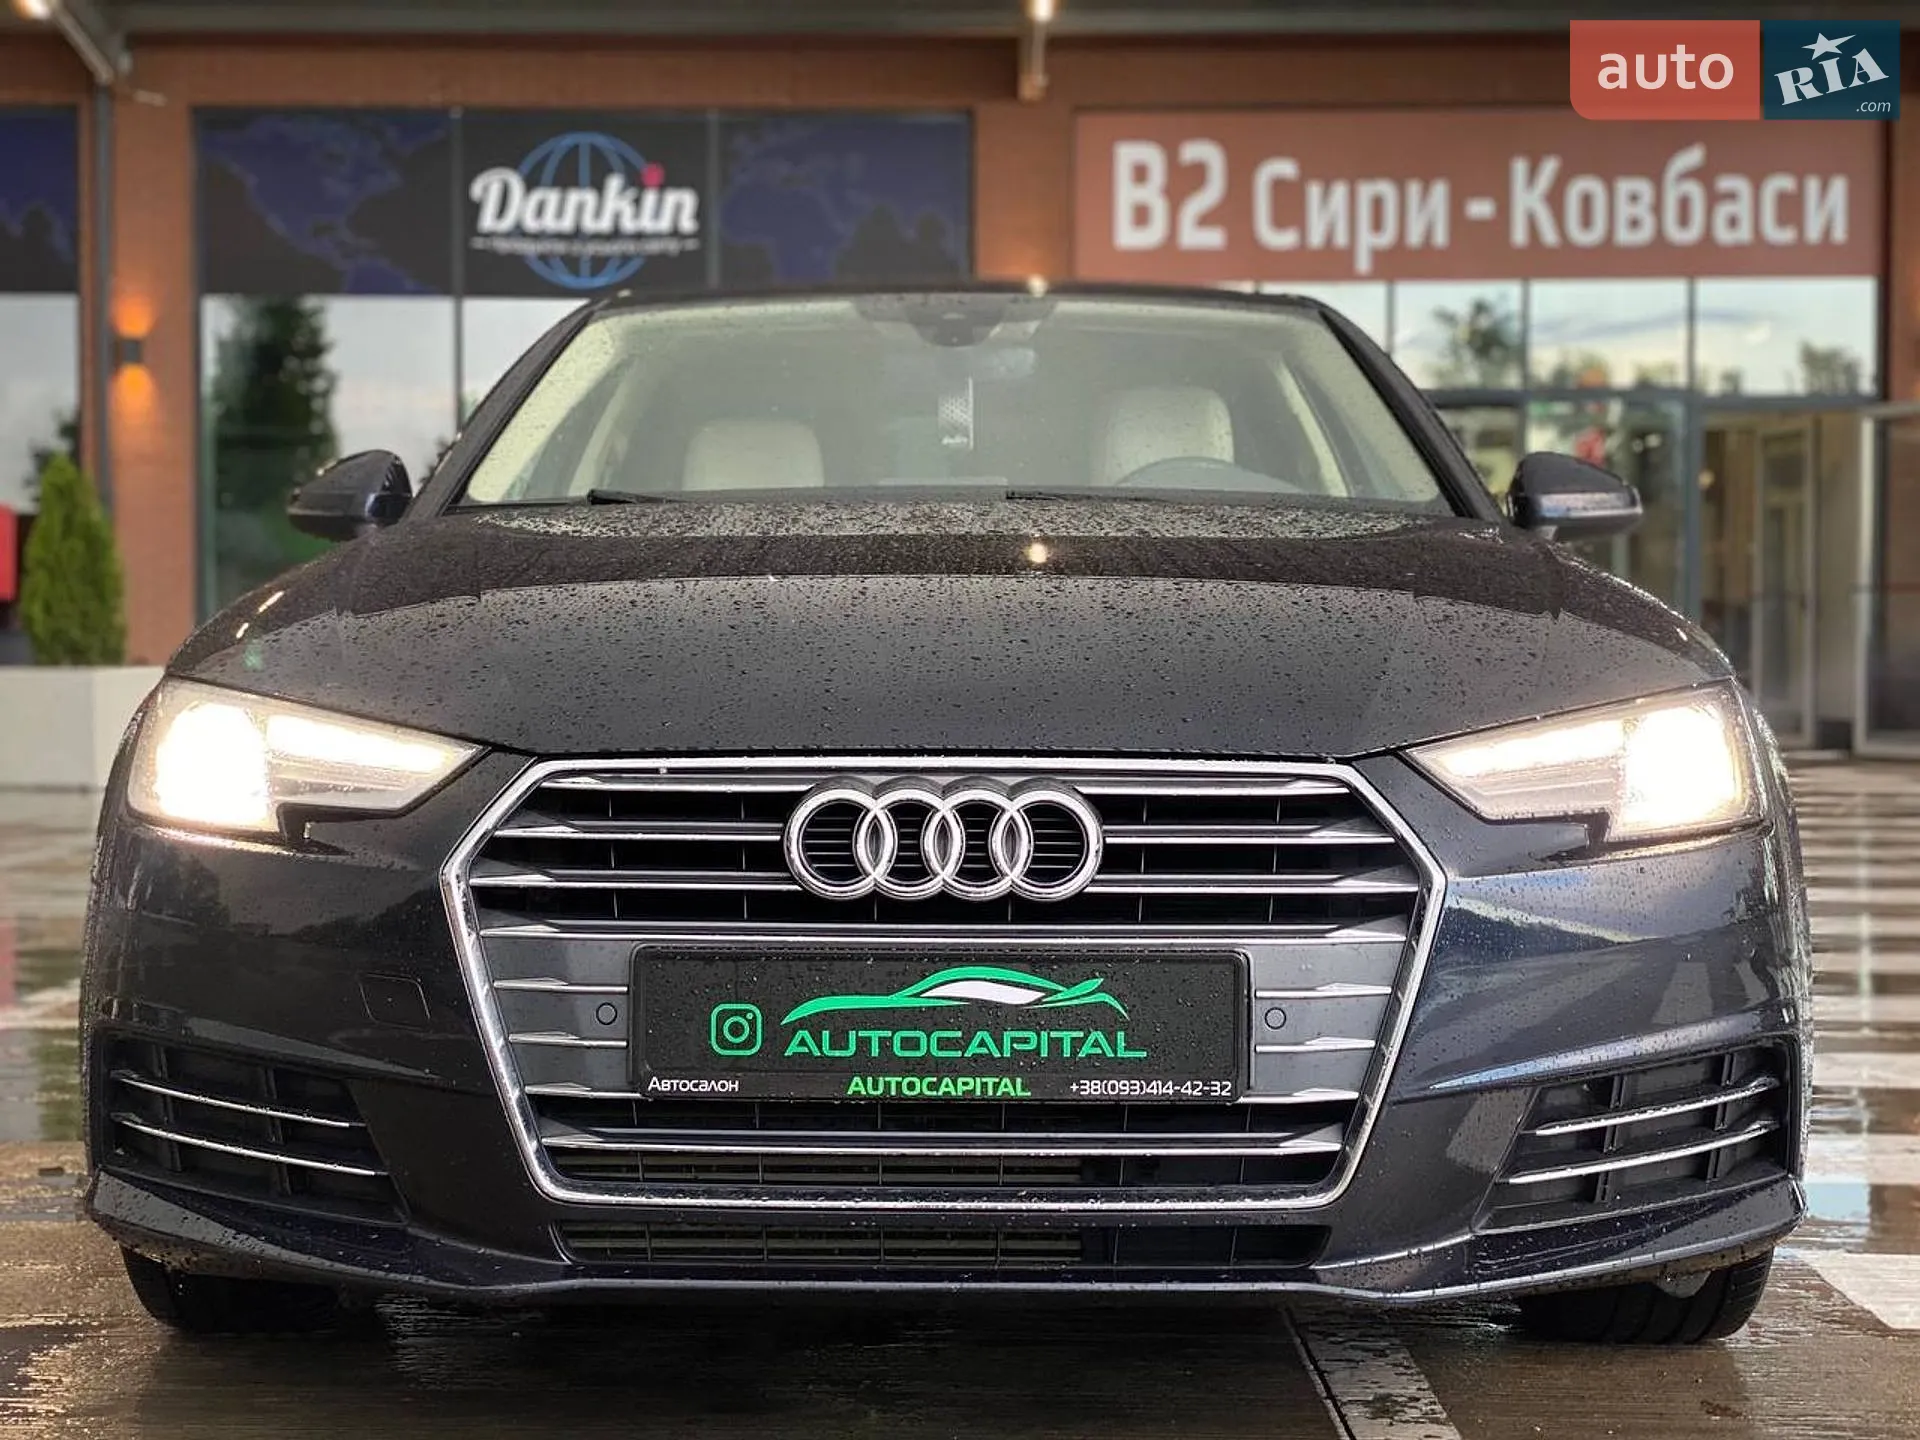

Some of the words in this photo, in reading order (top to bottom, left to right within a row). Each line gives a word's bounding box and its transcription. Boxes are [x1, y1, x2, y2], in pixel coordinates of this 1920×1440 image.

[469, 163, 700, 236] Dankin
[1252, 156, 1450, 276] Сири
[1508, 143, 1850, 248] Ковбаси
[783, 1029, 1148, 1059] AUTOCAPITAL
[647, 1076, 740, 1093] Автосалон
[847, 1075, 1032, 1098] AUTOCAPITAL
[1069, 1079, 1233, 1097] +38(093)414-42-32
